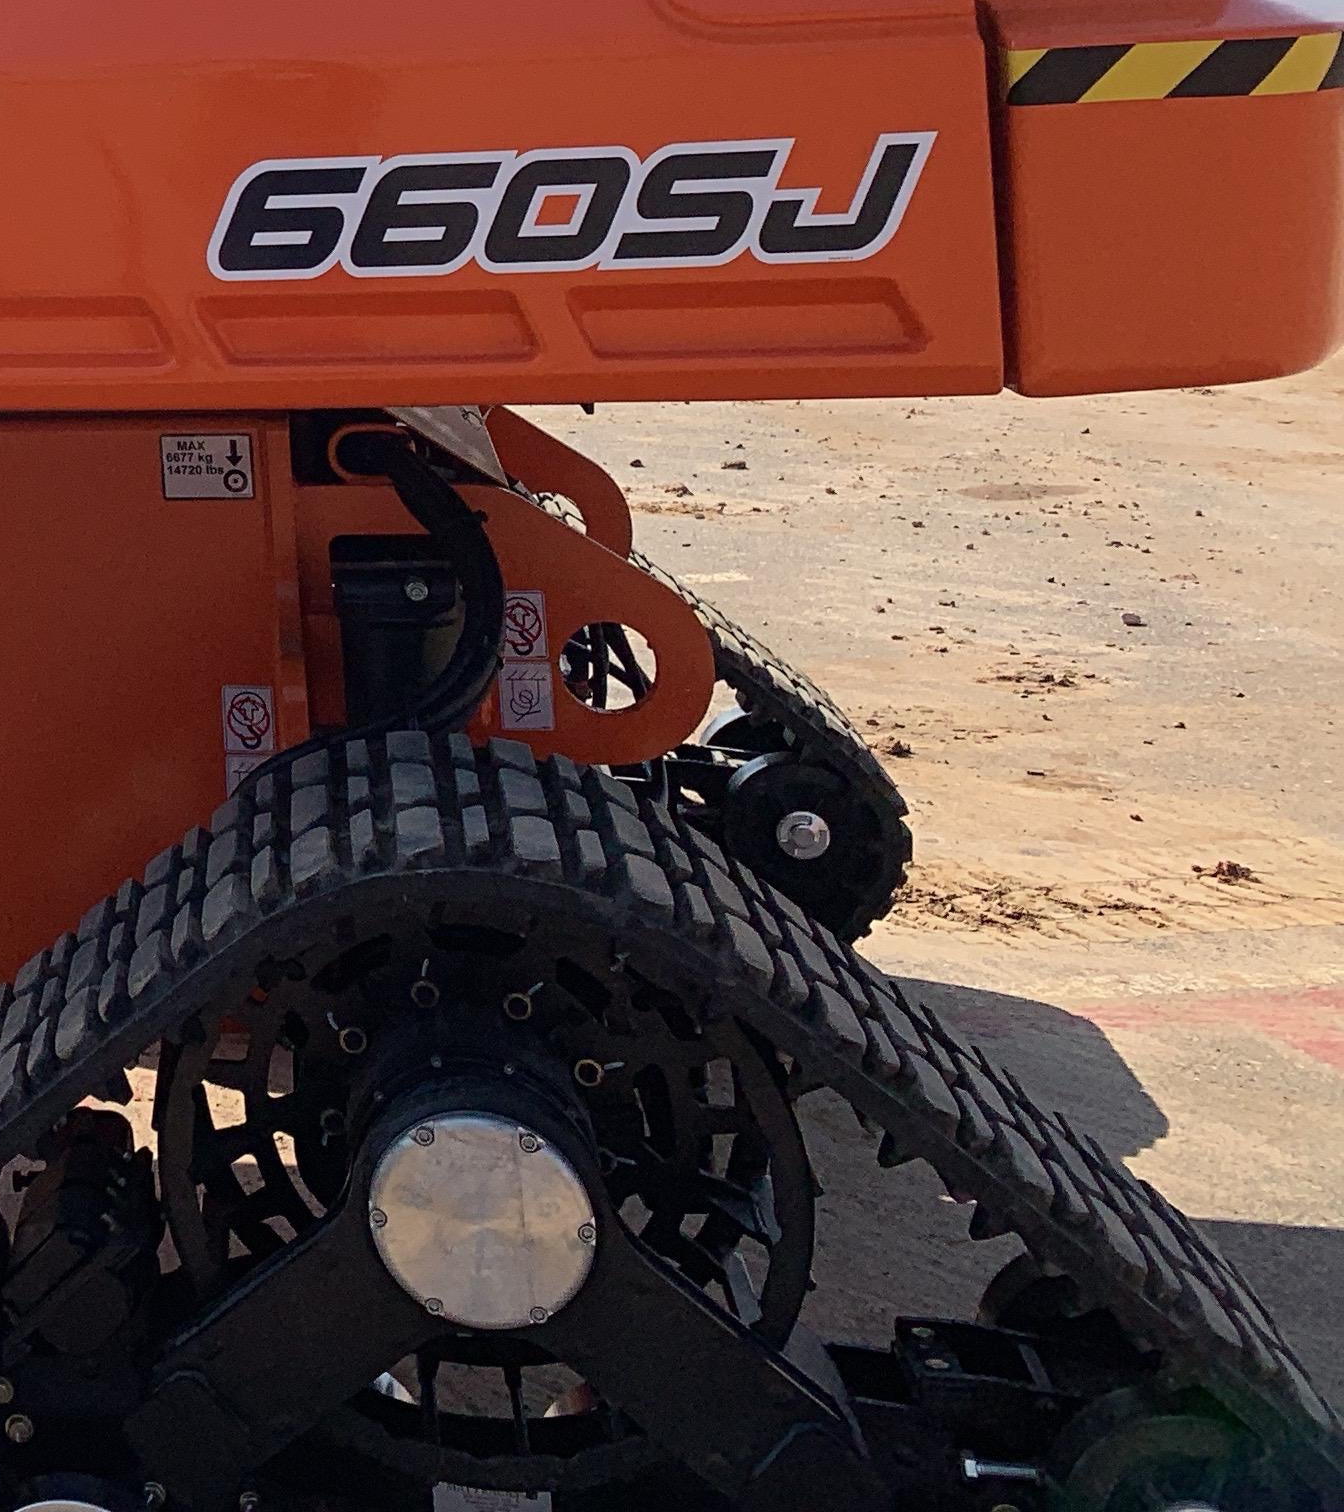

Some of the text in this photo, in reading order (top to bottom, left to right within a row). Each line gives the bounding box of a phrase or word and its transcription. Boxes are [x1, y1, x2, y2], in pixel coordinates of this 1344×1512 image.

[207, 131, 938, 281] 660SJ
[177, 440, 205, 451] MAX
[198, 452, 213, 464] kg
[167, 465, 224, 475] 14720 lbs
